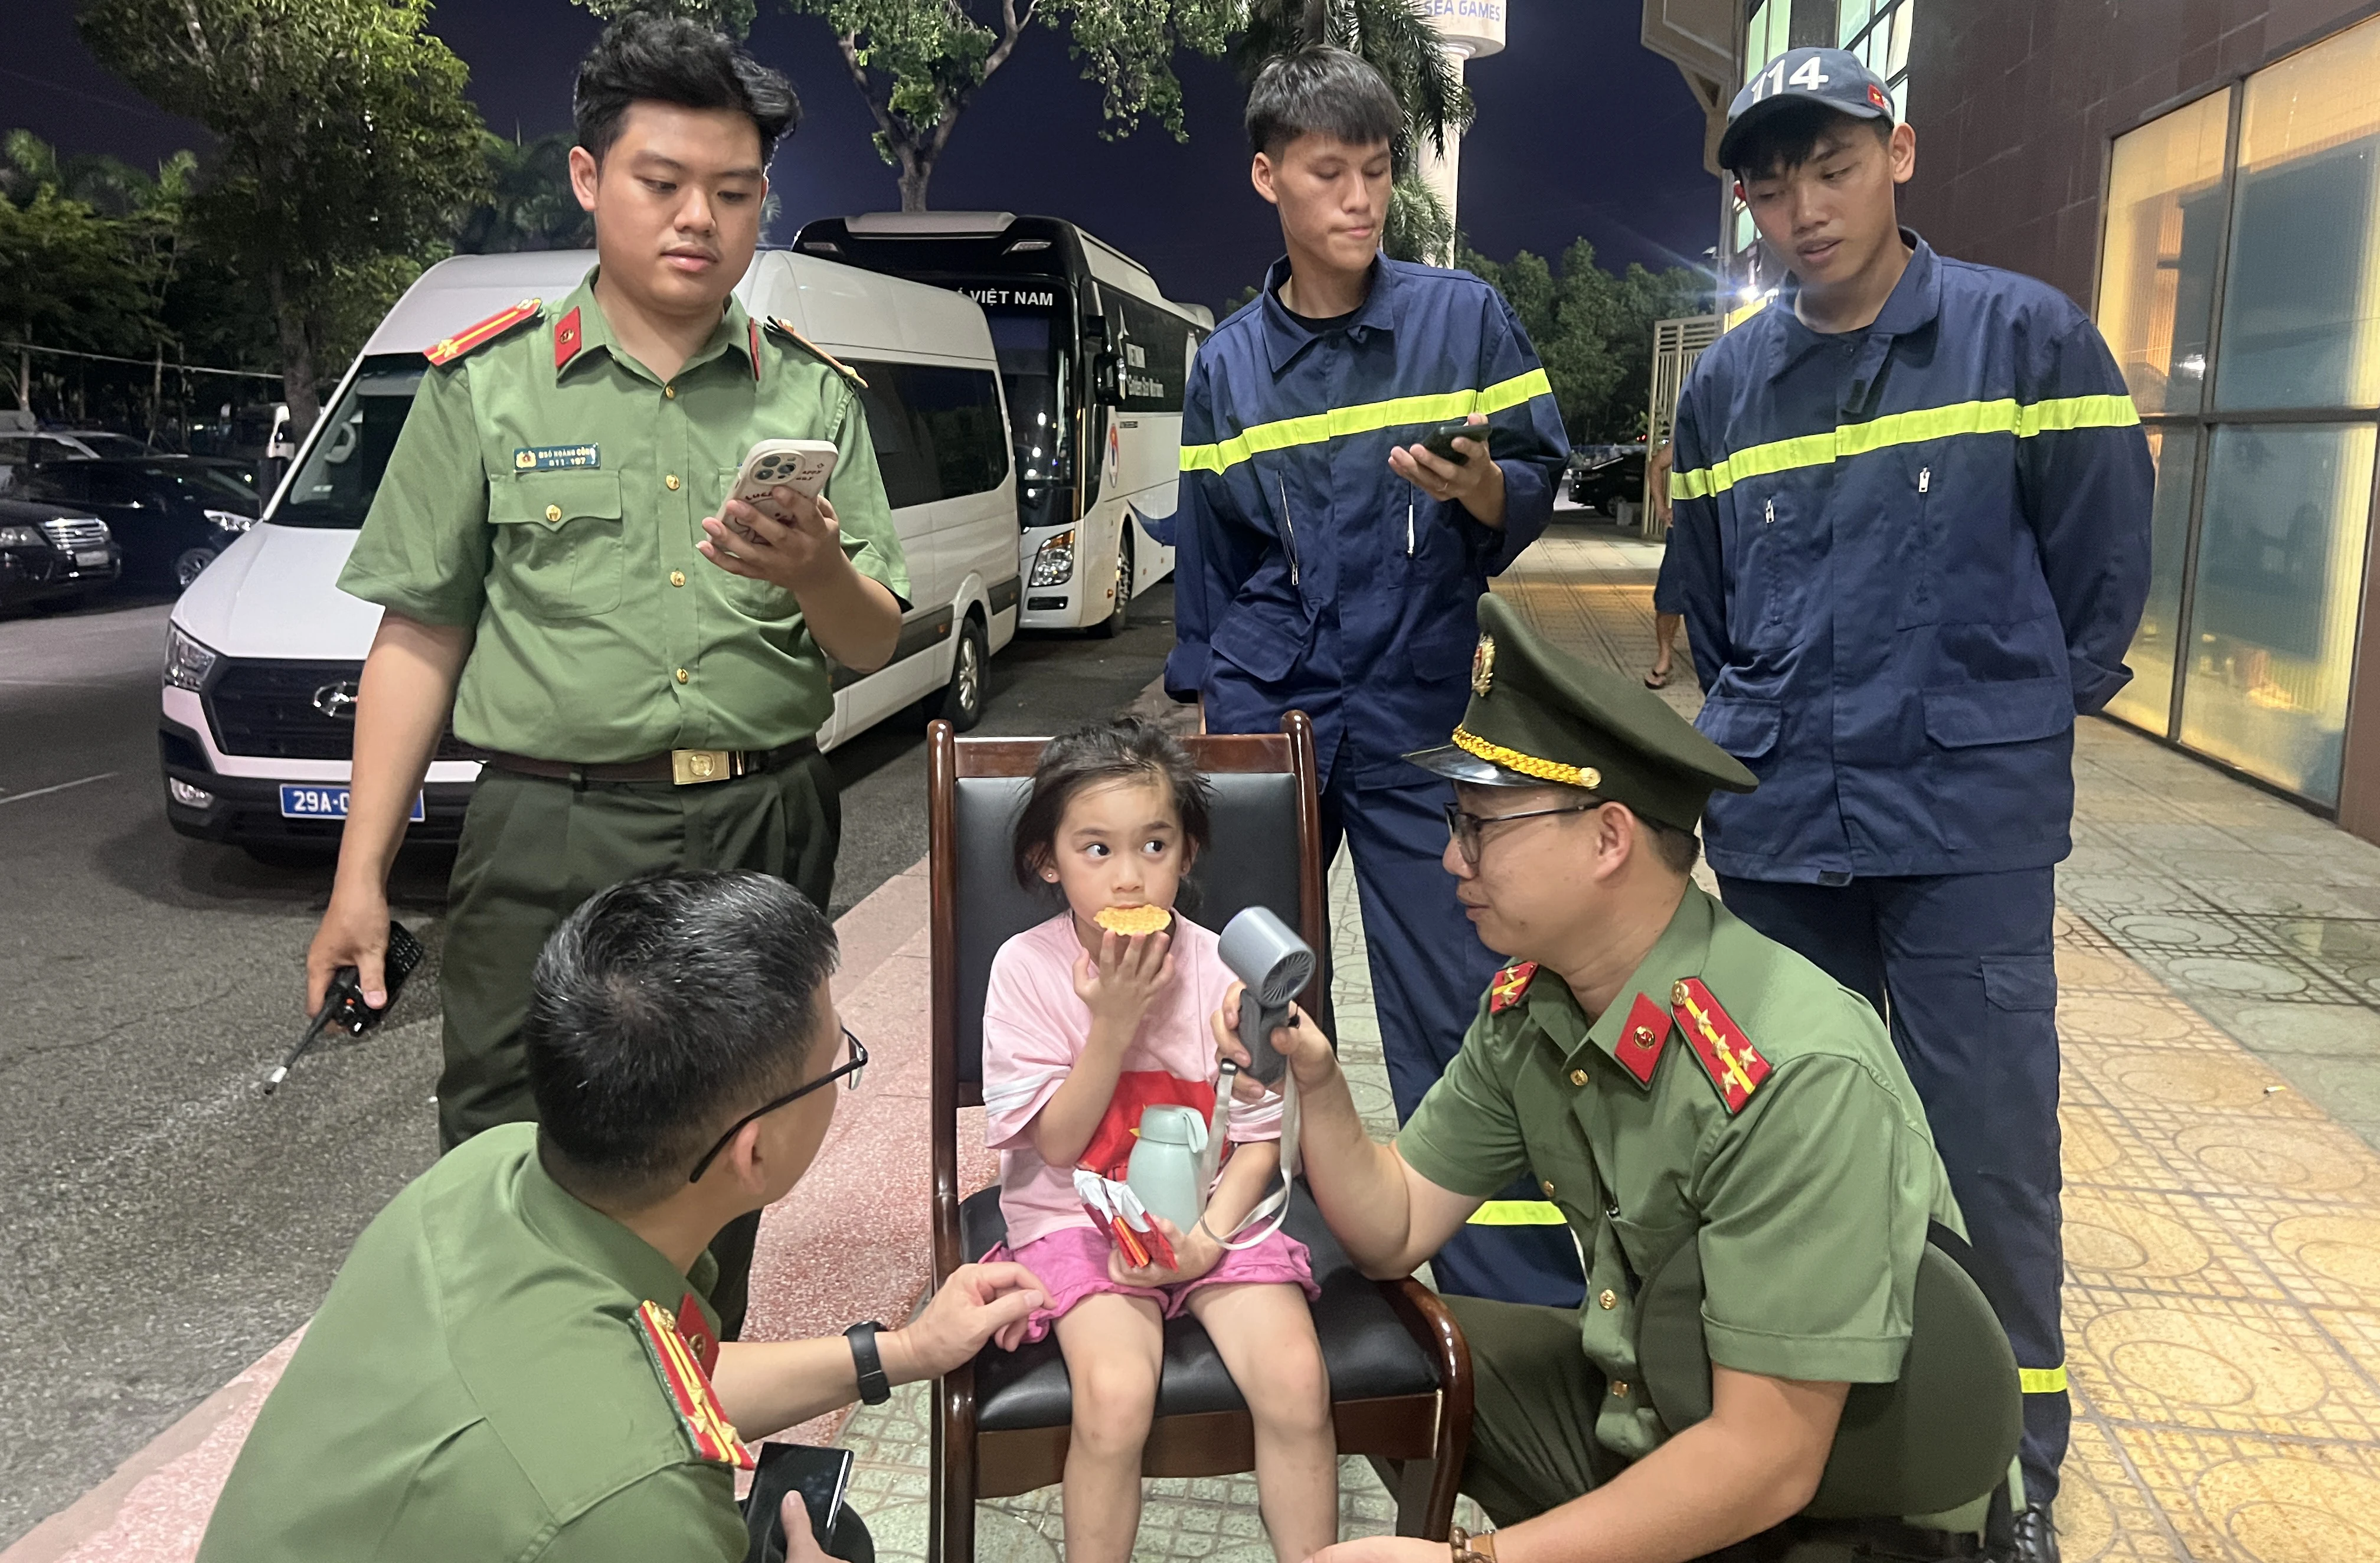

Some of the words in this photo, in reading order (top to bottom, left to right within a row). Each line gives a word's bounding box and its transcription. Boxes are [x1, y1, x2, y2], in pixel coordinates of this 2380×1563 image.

[1425, 0, 1454, 15] SEA
[1459, 0, 1500, 22] GAMES
[1751, 56, 1829, 104] 114
[970, 288, 1009, 306] VIỆT
[1015, 291, 1053, 306] NAM
